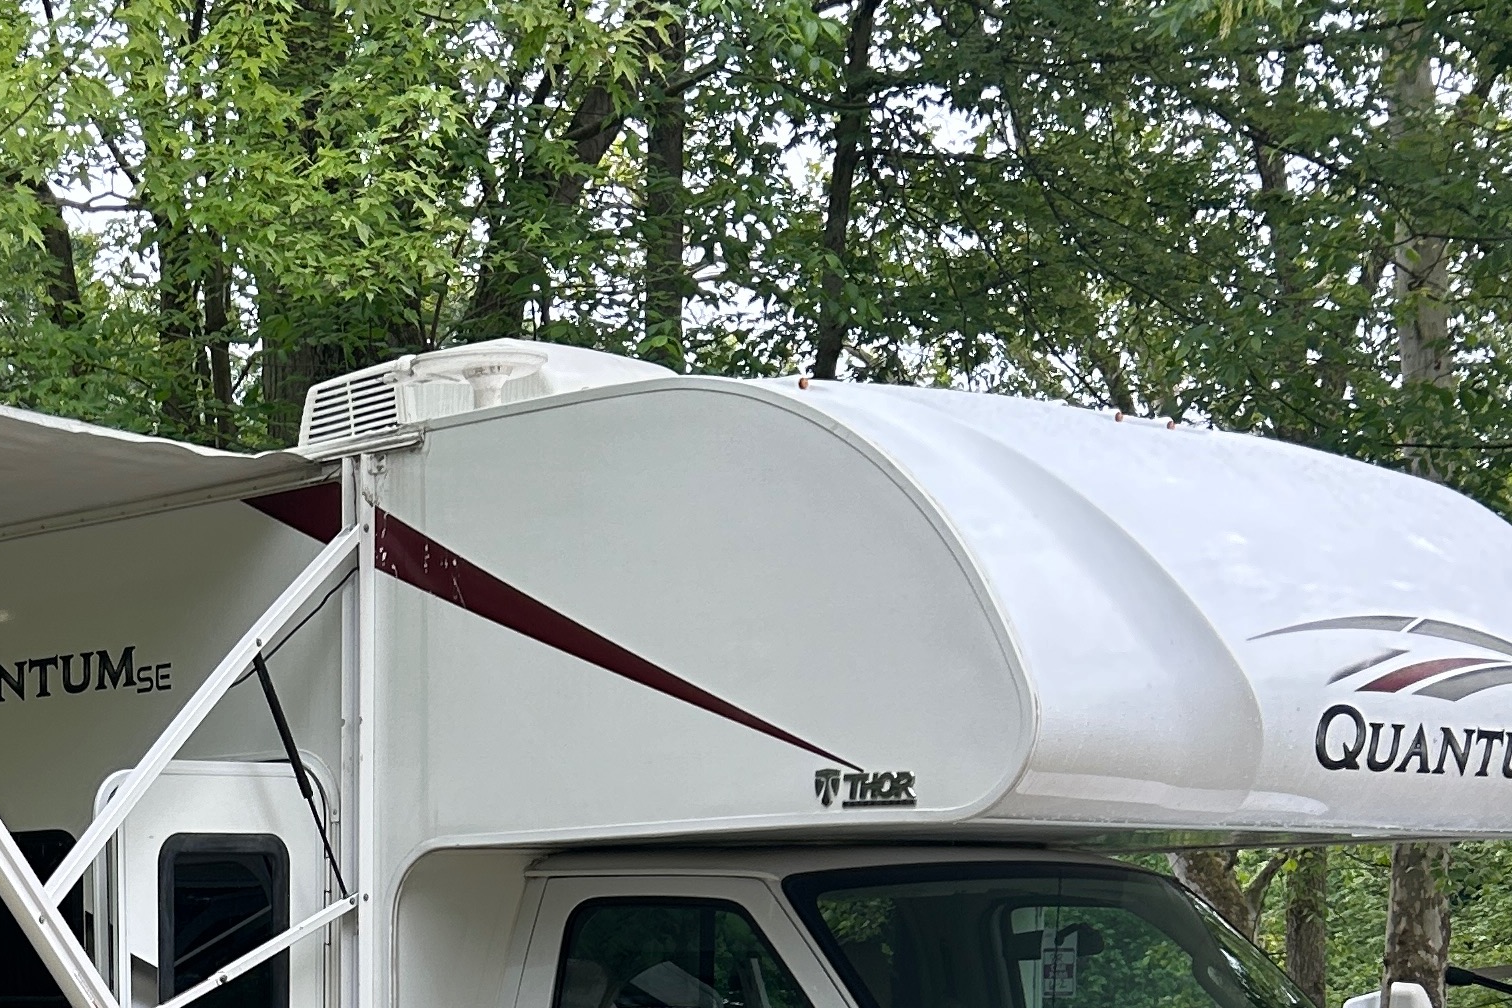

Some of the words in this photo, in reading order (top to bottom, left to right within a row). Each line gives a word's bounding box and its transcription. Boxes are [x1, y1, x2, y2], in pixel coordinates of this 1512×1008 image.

[137, 662, 172, 694] SE
[1315, 703, 1512, 779] QUANT
[843, 771, 917, 801] THOR
